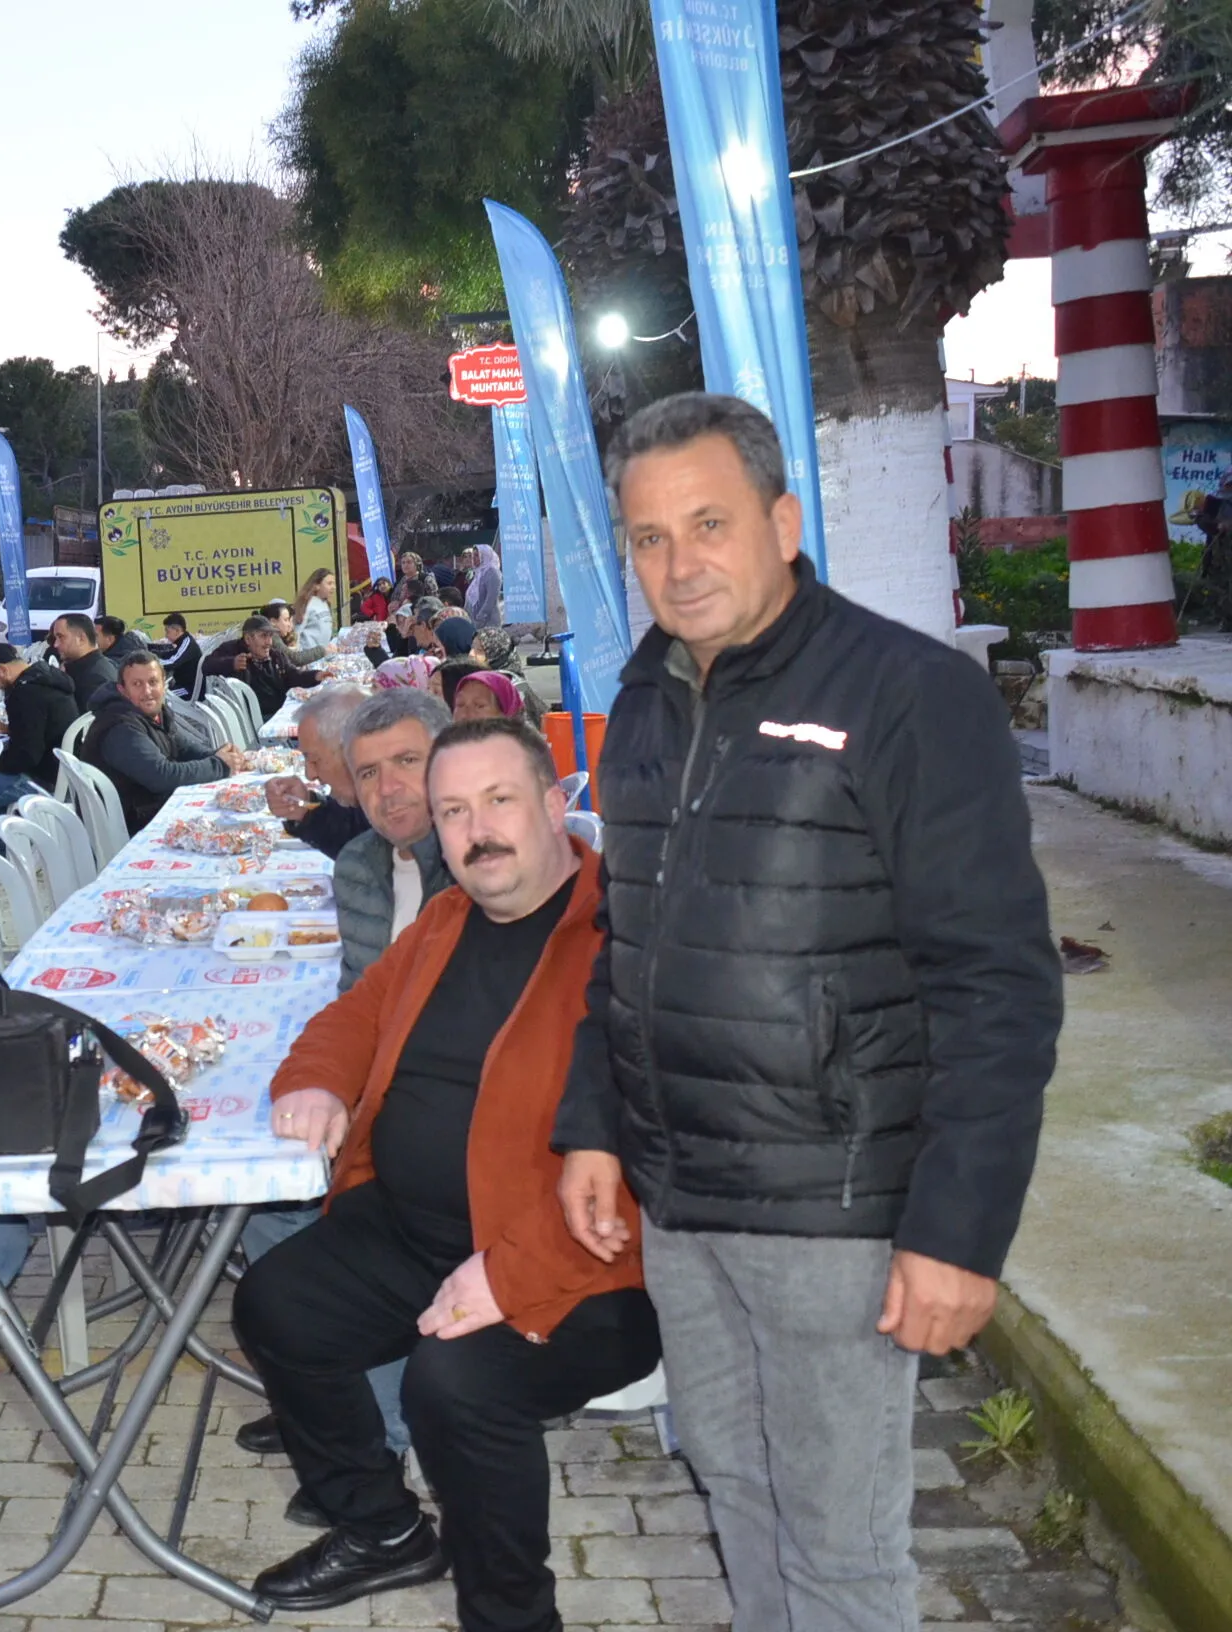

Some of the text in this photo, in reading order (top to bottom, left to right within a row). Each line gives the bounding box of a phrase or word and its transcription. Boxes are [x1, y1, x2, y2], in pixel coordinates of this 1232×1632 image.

[461, 369, 490, 380] BALAT
[1182, 449, 1217, 464] Halk
[1172, 466, 1222, 481] Ekmek
[166, 504, 193, 514] AYDIN
[195, 499, 251, 512] BÜYÜKŞEHİR
[184, 547, 255, 562] T.C. AYDIN
[157, 558, 283, 583] BÜYÜKŞEHİR
[180, 579, 262, 598] BELEDİYESİ
